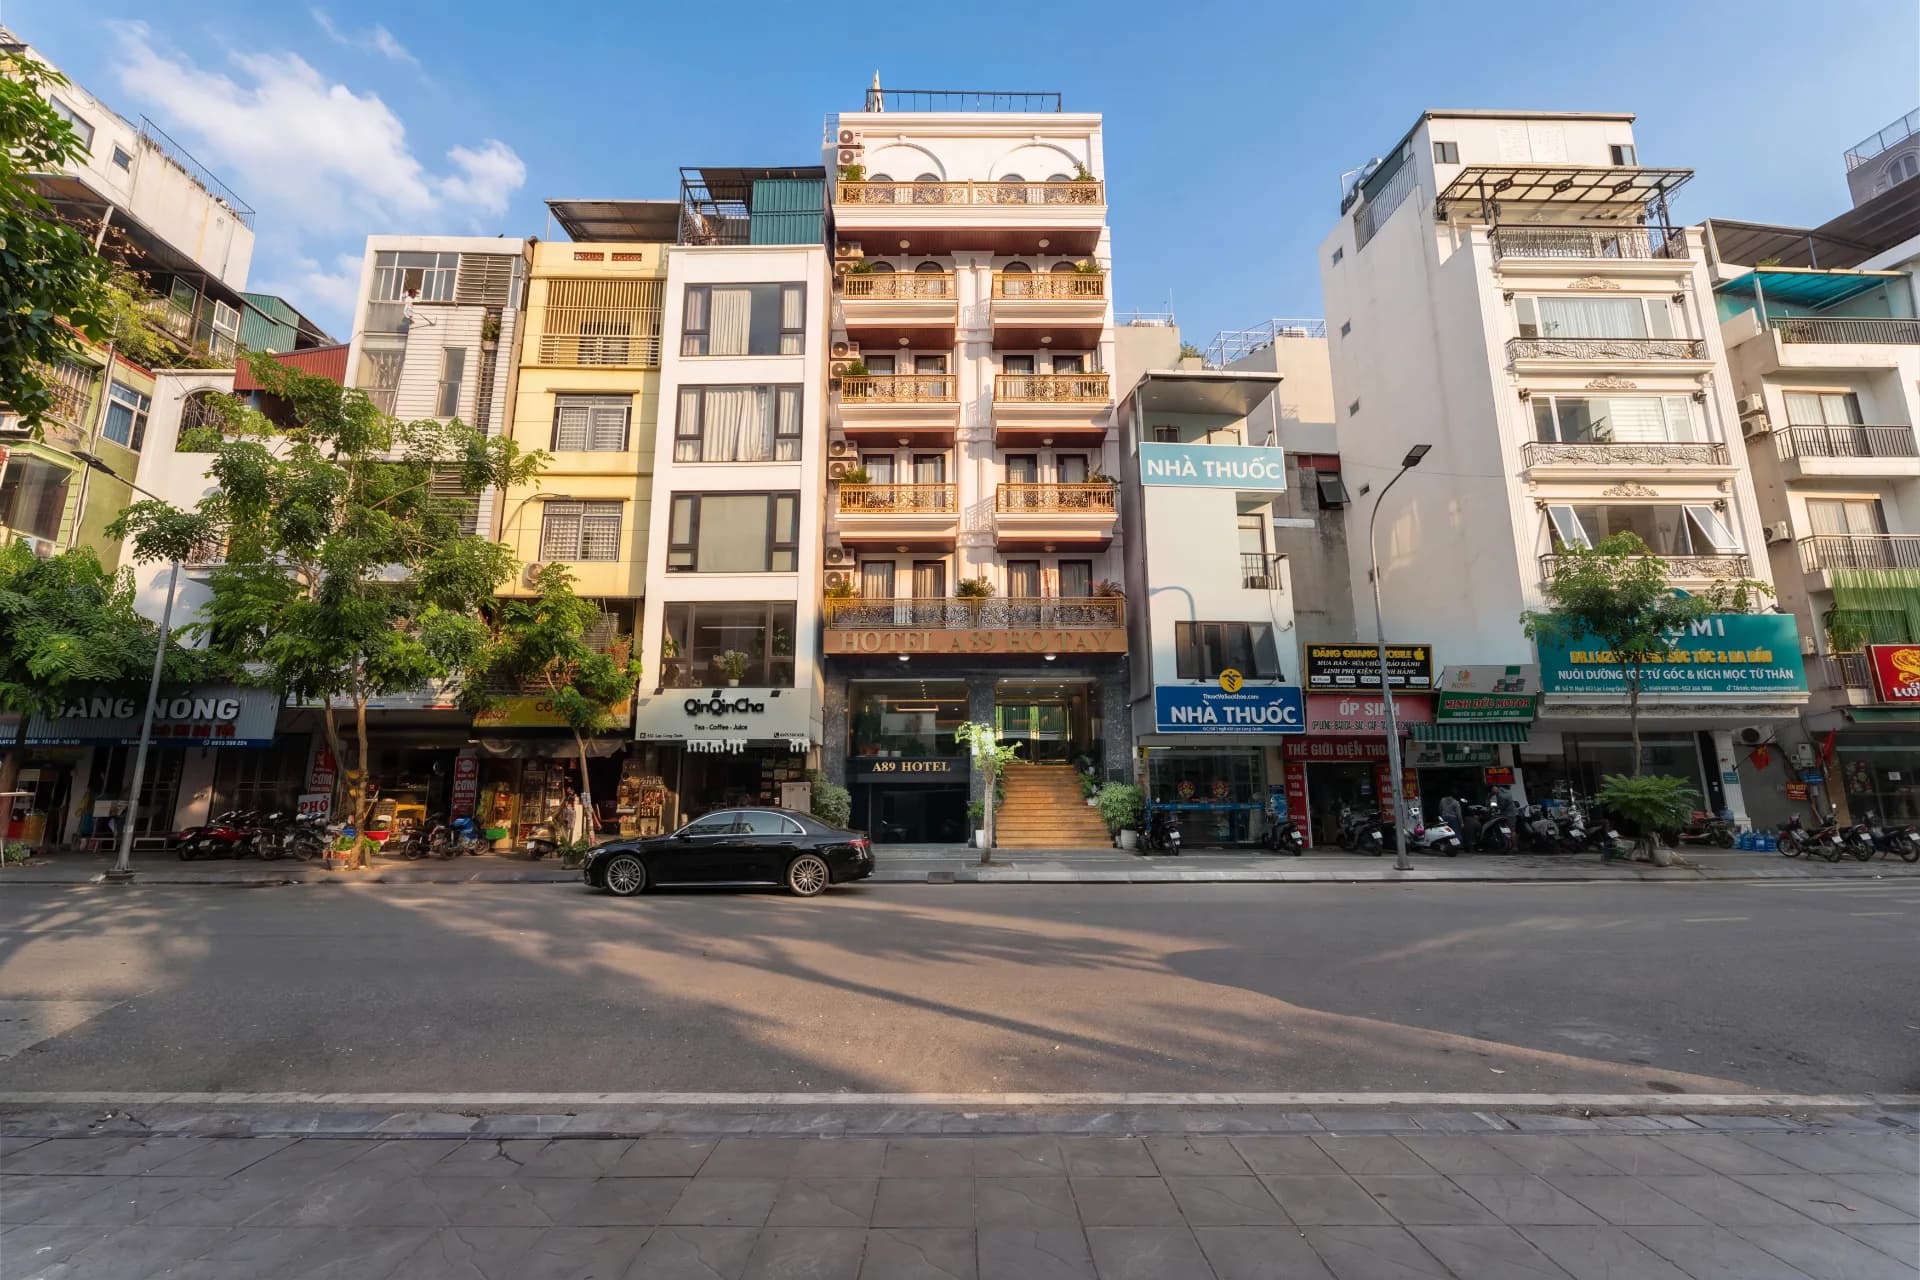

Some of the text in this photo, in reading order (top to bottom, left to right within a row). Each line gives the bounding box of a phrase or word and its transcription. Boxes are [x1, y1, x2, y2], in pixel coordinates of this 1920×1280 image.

[1147, 454, 1281, 480] NHÀ THUỐC
[1654, 618, 1726, 637] UMI
[840, 631, 933, 652] HOTEL
[950, 632, 996, 653] A89
[1312, 648, 1412, 660] ĐĂNG QUANG OBILE
[1718, 650, 1728, 664] &
[1365, 660, 1381, 669] CHỮ
[1558, 667, 1584, 680] NUÔI
[1586, 667, 1623, 680] DƯỠNG
[1663, 666, 1685, 679] GỐC
[1687, 669, 1695, 680] &
[1697, 668, 1721, 680] KÍCH
[1723, 669, 1747, 682] MỌC
[1749, 667, 1766, 679] TỪ
[1767, 667, 1793, 680] THÂN
[150, 690, 240, 720] NÓNG
[684, 698, 765, 716] QinQinCha
[1170, 698, 1297, 725] NHÀ THUỐC
[1339, 698, 1359, 716] ỐP
[1445, 698, 1470, 709] MINH
[1496, 698, 1530, 708] MOTOR
[709, 723, 729, 731] Coffee
[1287, 741, 1308, 757] THẾ
[1366, 744, 1387, 757] THO
[872, 762, 950, 773] A89 HOTEL
